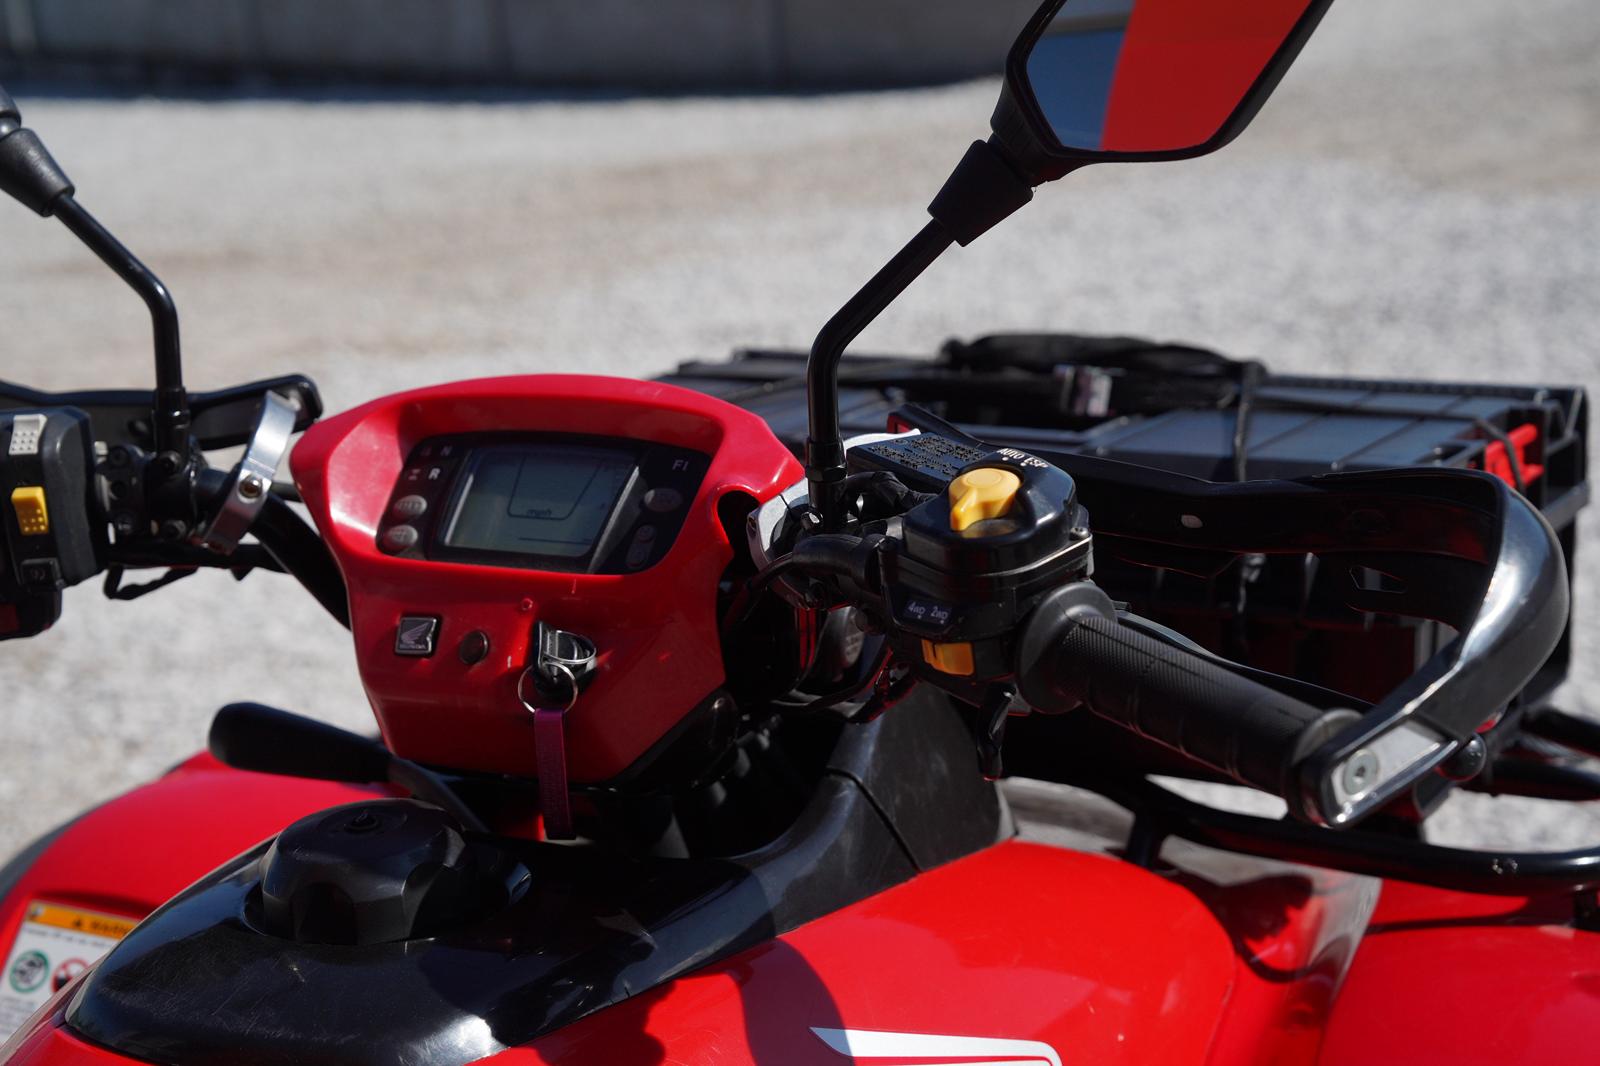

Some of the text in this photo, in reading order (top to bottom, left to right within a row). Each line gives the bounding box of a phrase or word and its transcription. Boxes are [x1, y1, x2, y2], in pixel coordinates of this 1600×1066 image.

[996, 447, 1050, 468] AUTO ESP
[671, 459, 690, 471] FI
[428, 467, 441, 481] R
